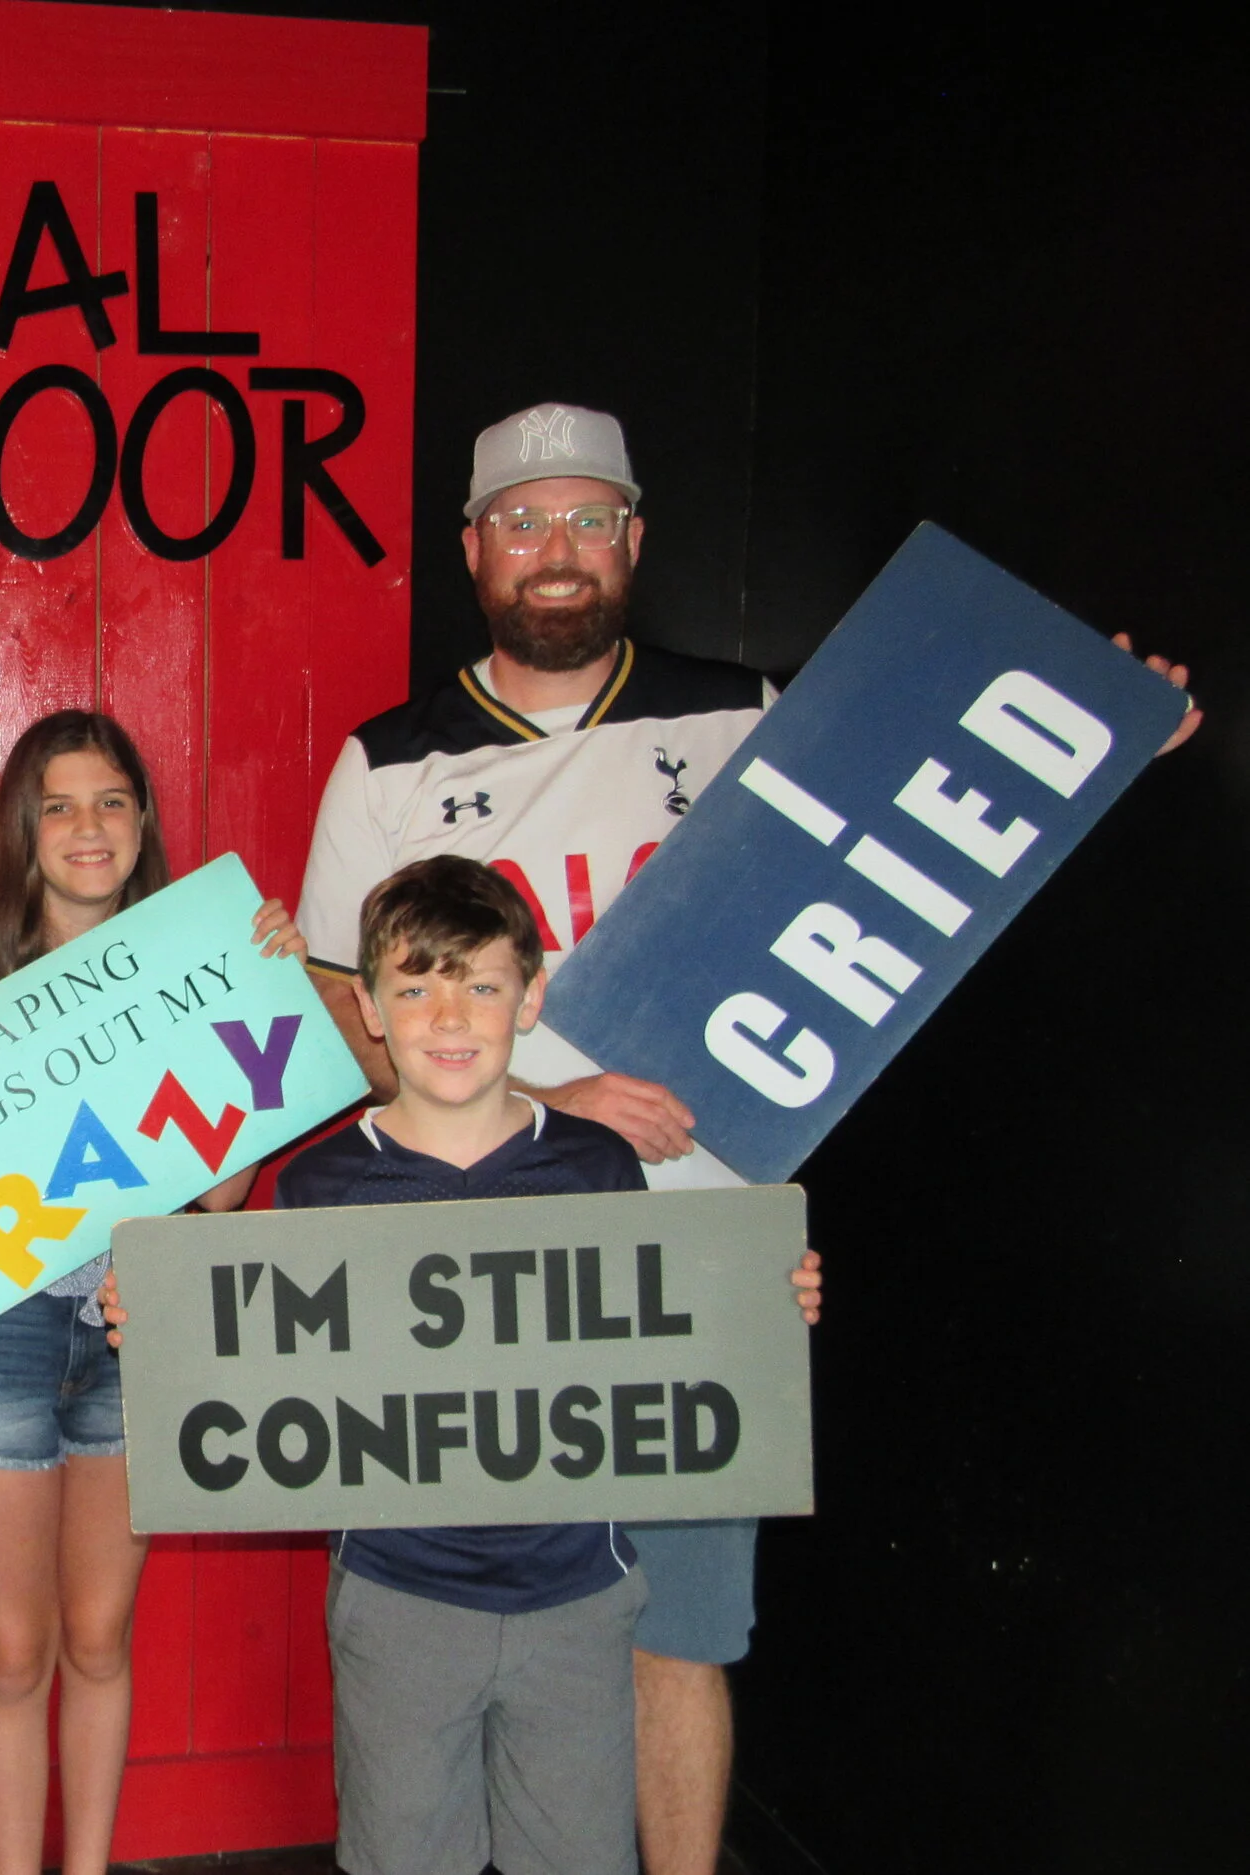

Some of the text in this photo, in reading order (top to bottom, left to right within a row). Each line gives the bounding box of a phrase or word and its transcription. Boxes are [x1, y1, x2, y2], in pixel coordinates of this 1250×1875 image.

[738, 758, 846, 845] I
[704, 670, 1111, 1108] CRIED
[45, 1004, 147, 1086] OUT
[155, 952, 235, 1024] MY
[212, 1244, 692, 1356] I'M STILL
[179, 1381, 740, 1492] CONFUSED
